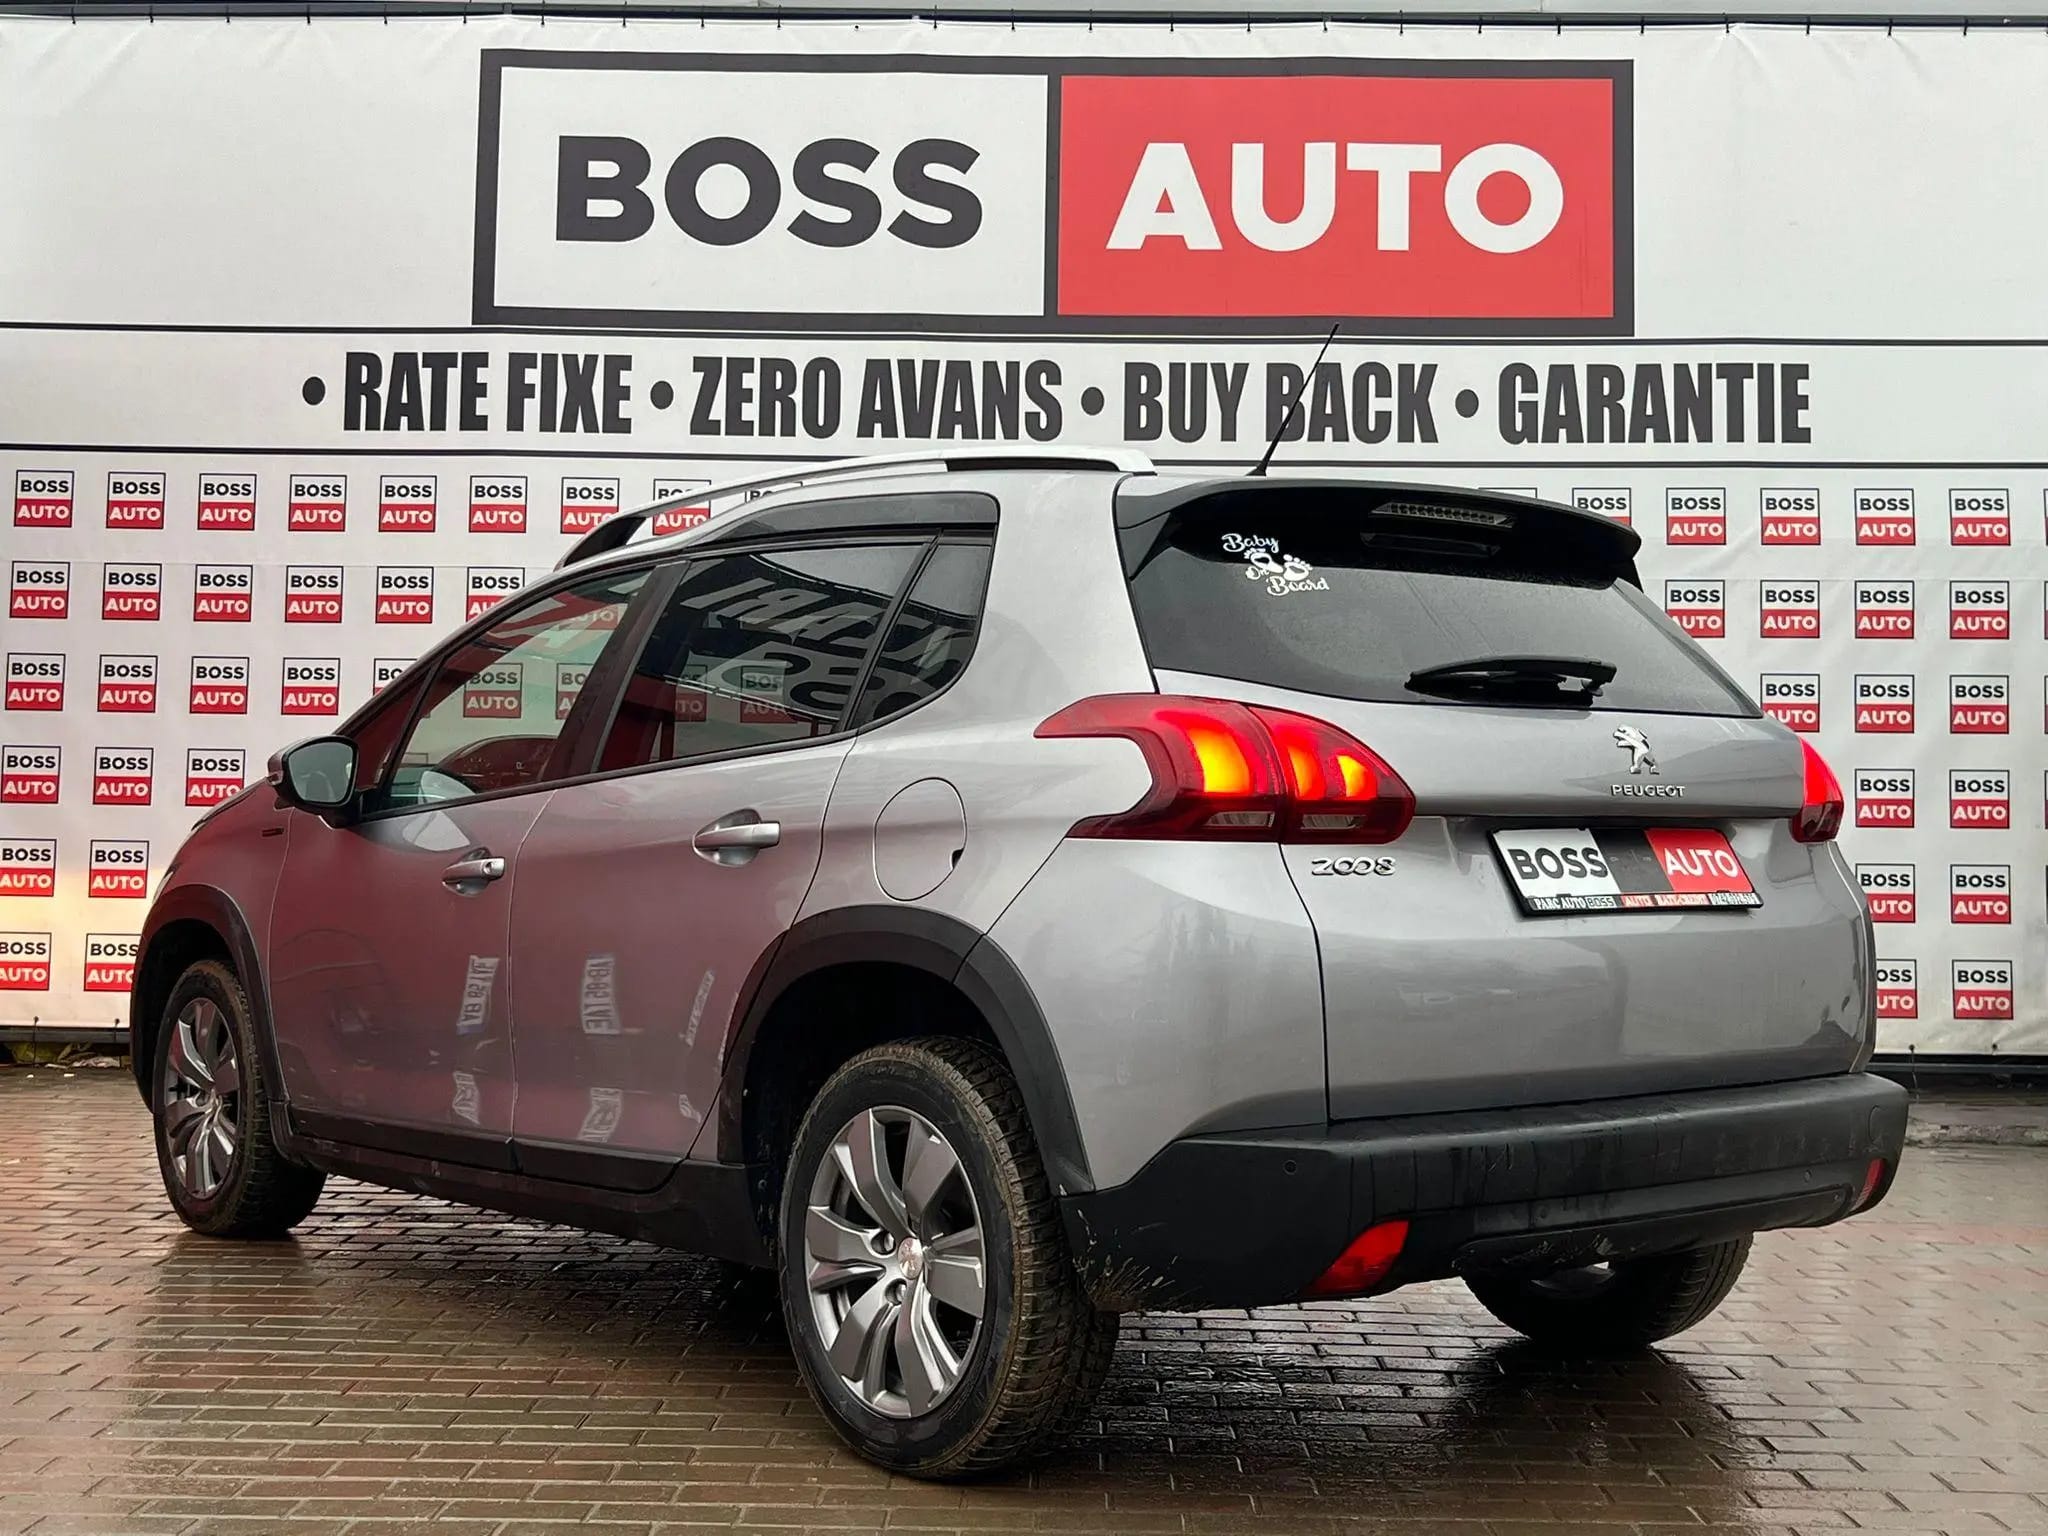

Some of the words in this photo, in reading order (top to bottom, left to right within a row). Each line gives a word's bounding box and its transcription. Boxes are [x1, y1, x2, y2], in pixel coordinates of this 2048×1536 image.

[556, 136, 983, 248] BOSS
[1107, 142, 1563, 253] AUTO
[344, 352, 489, 431] RATE
[507, 352, 632, 434] FIXE
[690, 356, 841, 438] ZERO
[857, 359, 1062, 441] AVANS
[1124, 362, 1249, 443] BUY
[1266, 361, 1438, 444] BACK
[1499, 363, 1811, 444] GARANTIE
[20, 480, 69, 493] BOSS
[112, 481, 160, 495] BOSS
[204, 483, 252, 496] BOSS
[295, 484, 342, 497] BOSS
[385, 485, 432, 498] BOSS
[475, 485, 522, 498] BOSS
[566, 487, 614, 500] BOSS
[1578, 497, 1627, 510] BOSS
[1672, 497, 1721, 510] BOSS
[1766, 498, 1815, 510] BOSS
[1860, 498, 1909, 511] BOSS
[1955, 498, 2004, 511] BOSS
[17, 505, 69, 519] AUTO
[109, 507, 161, 521] AUTO
[200, 508, 252, 522] AUTO
[291, 509, 343, 523] AUTO
[381, 510, 433, 524] AUTO
[471, 510, 524, 524] AUTO
[1669, 522, 1724, 537] AUTO
[1763, 523, 1818, 538] AUTO
[1858, 523, 1913, 537] AUTO
[1953, 523, 2008, 538] AUTO
[1221, 533, 1279, 553] Baby
[16, 570, 65, 584] BOSS
[108, 572, 156, 586] BOSS
[200, 574, 248, 587] BOSS
[291, 575, 338, 588] BOSS
[382, 576, 429, 589] BOSS
[472, 576, 520, 589] BOSS
[1266, 576, 1330, 596] Board
[13, 596, 65, 610] AUTO
[1670, 590, 1720, 603] BOSS
[1765, 590, 1815, 603] BOSS
[1860, 590, 1909, 603] BOSS
[1955, 591, 2004, 604] BOSS
[105, 598, 157, 612] AUTO
[196, 599, 248, 613] AUTO
[287, 601, 339, 614] AUTO
[378, 601, 430, 615] AUTO
[1763, 615, 1817, 630] AUTO
[1857, 616, 1912, 630] AUTO
[1953, 616, 2007, 631] AUTO
[12, 663, 60, 676] BOSS
[104, 664, 152, 678] BOSS
[196, 666, 244, 679] BOSS
[287, 667, 335, 680] BOSS
[378, 668, 402, 681] BO
[561, 672, 587, 685] BO
[8, 688, 60, 702] AUTO
[101, 690, 153, 704] AUTO
[1766, 684, 1815, 697] BOSS
[1860, 685, 1910, 697] BOSS
[1955, 685, 2004, 698] BOSS
[192, 691, 245, 705] AUTO
[284, 693, 336, 707] AUTO
[466, 696, 518, 710] AUTO
[1857, 710, 1912, 725] AUTO
[1953, 711, 2007, 725] AUTO
[7, 755, 56, 769] BOSS
[99, 757, 148, 770] BOSS
[192, 758, 240, 772] BOSS
[3, 781, 56, 795] AUTO
[96, 782, 148, 796] AUTO
[1611, 784, 1685, 797] PEUGEOT
[1860, 779, 1910, 792] BOSS
[1955, 780, 2005, 793] BOSS
[1858, 805, 1911, 819] AUTO
[1953, 806, 2007, 820] AUTO
[2, 848, 51, 861] BOSS
[95, 850, 144, 863] BOSS
[1311, 857, 1396, 876] 2008
[1507, 848, 1609, 880] BOSS
[1663, 848, 1739, 878] AUTO
[0, 874, 52, 888] AUTO
[91, 875, 145, 890] AUTO
[1861, 874, 1910, 887] BOSS
[1956, 875, 2006, 888] BOSS
[1533, 898, 1562, 911] PARC
[1561, 897, 1587, 910] AUTO
[1587, 898, 1615, 909] BOSS
[1870, 900, 1912, 914] UTO
[1954, 901, 2008, 915] AUTO
[0, 942, 46, 955] BOSS
[91, 944, 138, 956] BOSS
[1876, 969, 1912, 982] OSS
[1958, 970, 2008, 983] BOSS
[1876, 995, 1915, 1010] UTO
[1956, 996, 2010, 1010] AUTO
